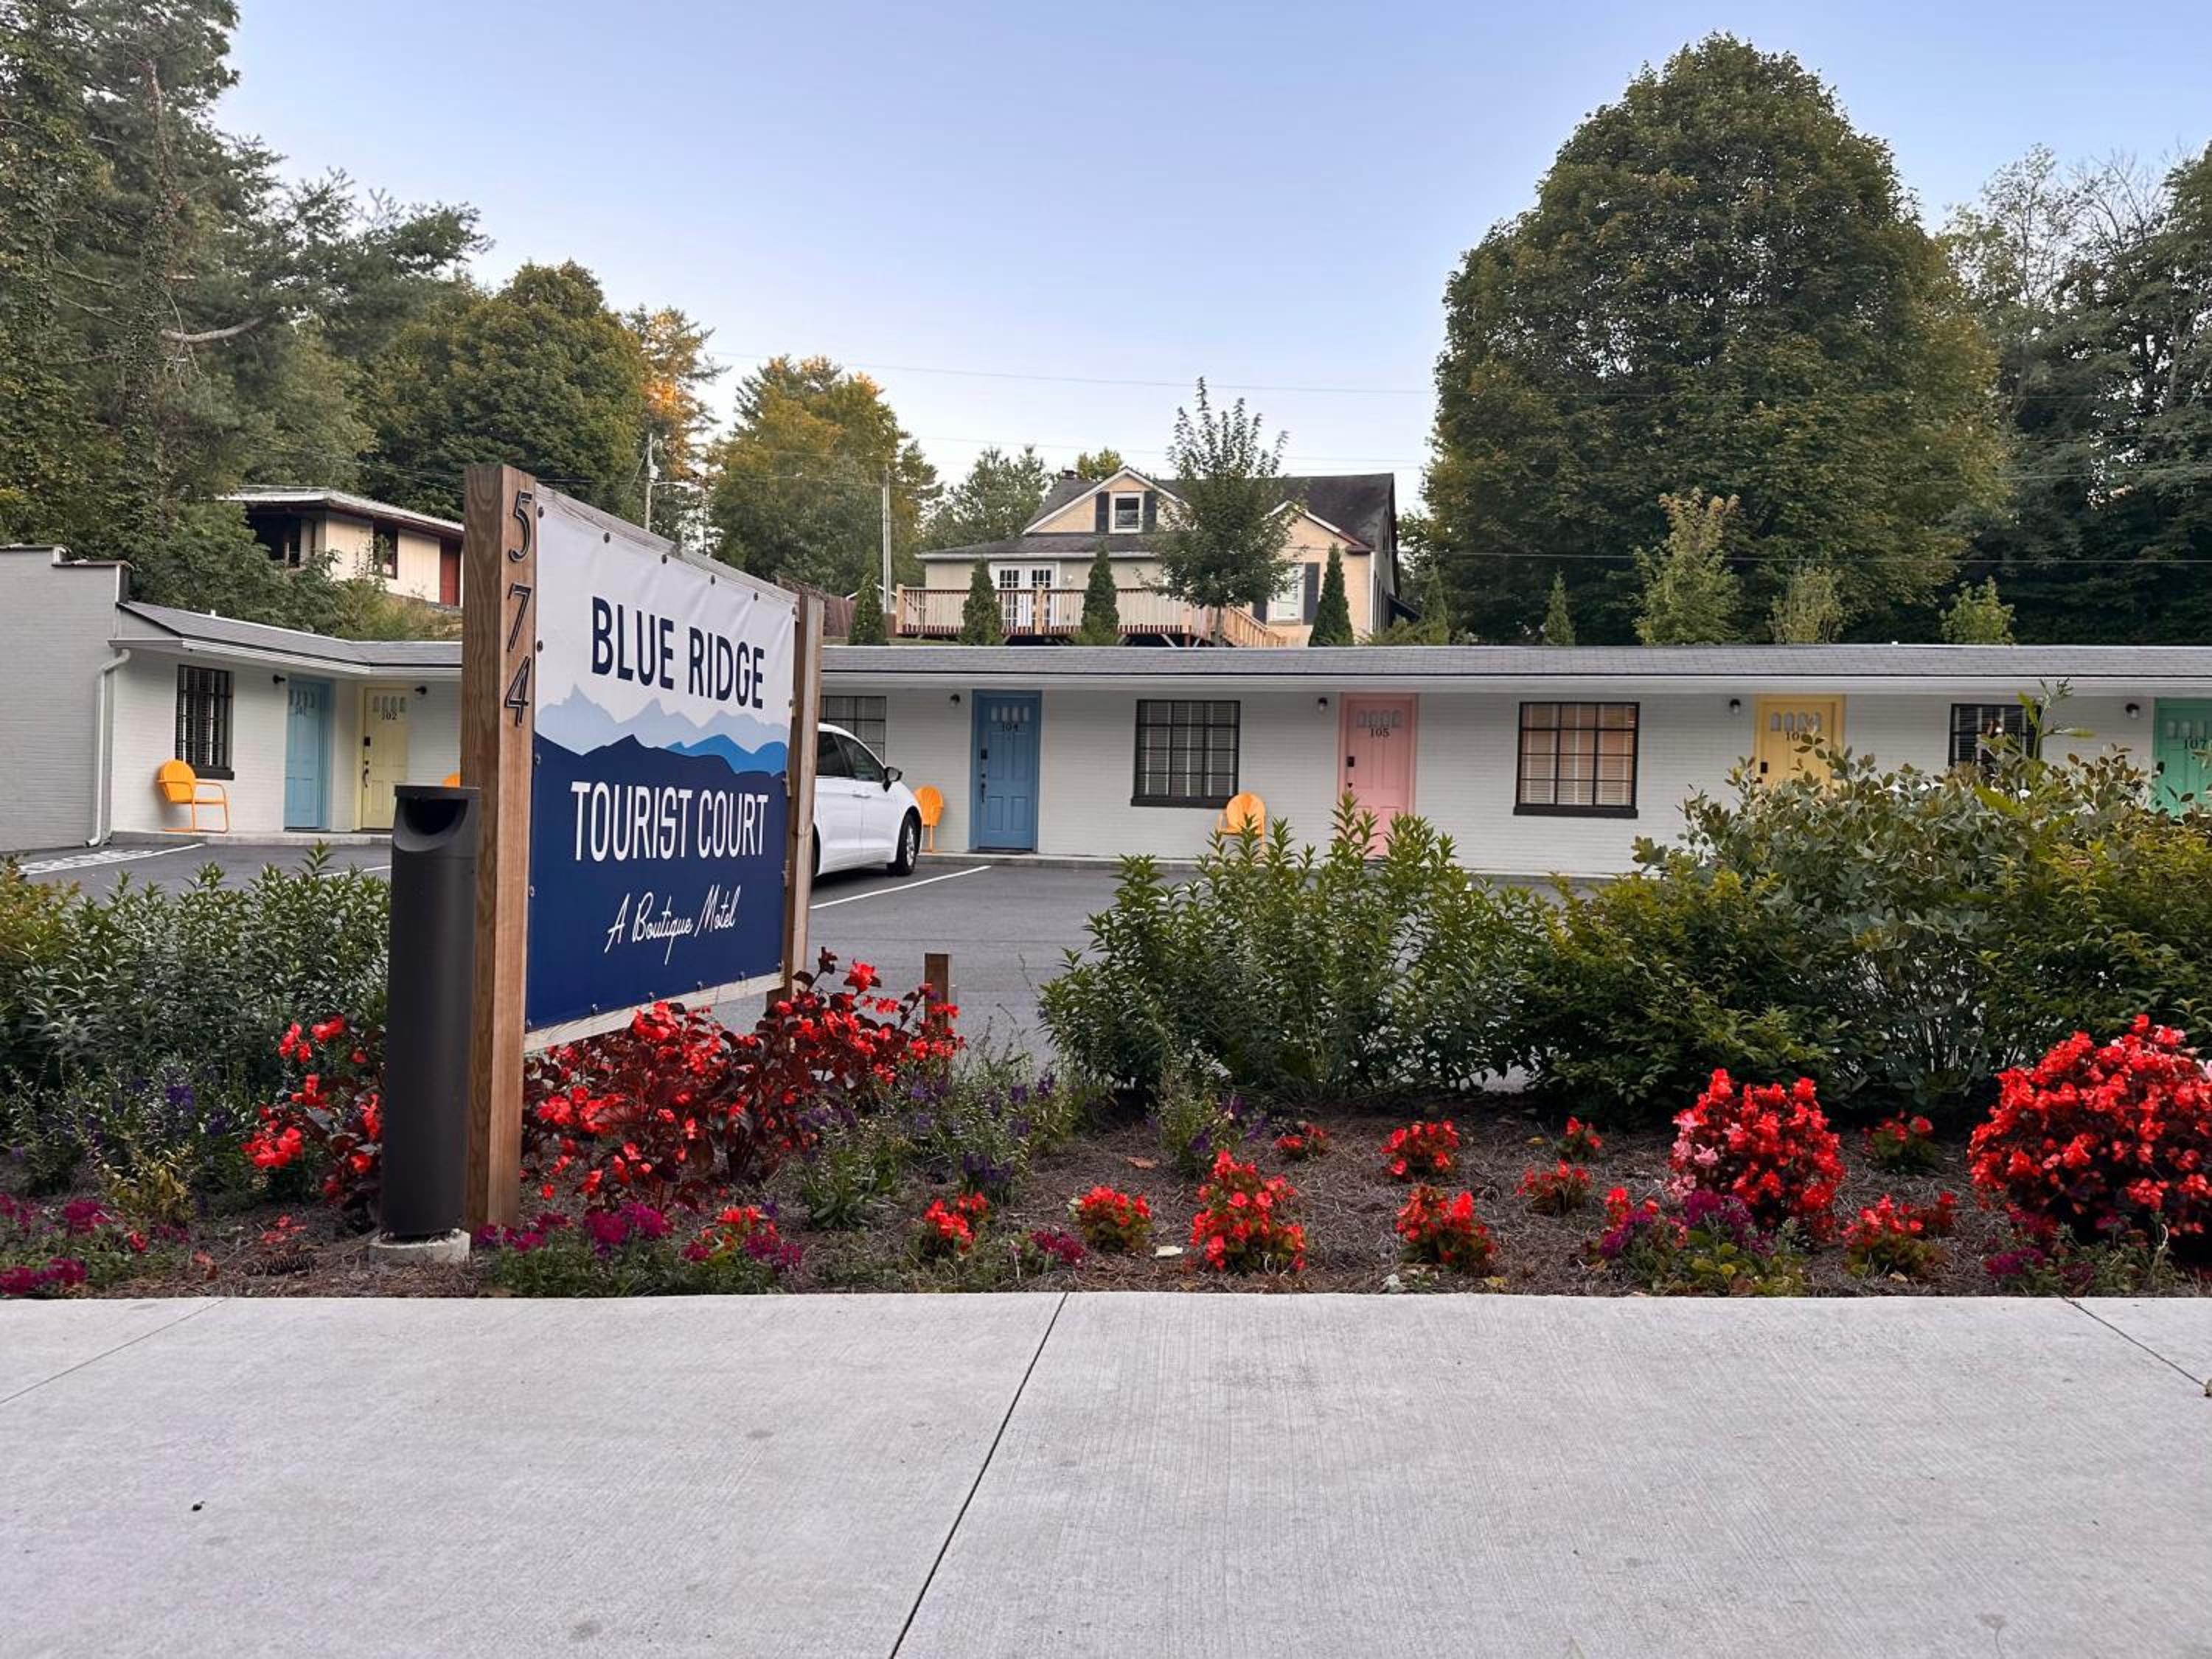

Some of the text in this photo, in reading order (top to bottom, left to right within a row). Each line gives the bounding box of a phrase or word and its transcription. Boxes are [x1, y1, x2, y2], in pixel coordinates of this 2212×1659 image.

[504, 489, 533, 726] 574
[592, 597, 764, 709] BLUE RIDGE
[1369, 728, 1391, 737] 105
[1785, 731, 1805, 742] 10
[571, 781, 769, 862] TOURIST COURT
[605, 884, 741, 965] A Boutique Motel
